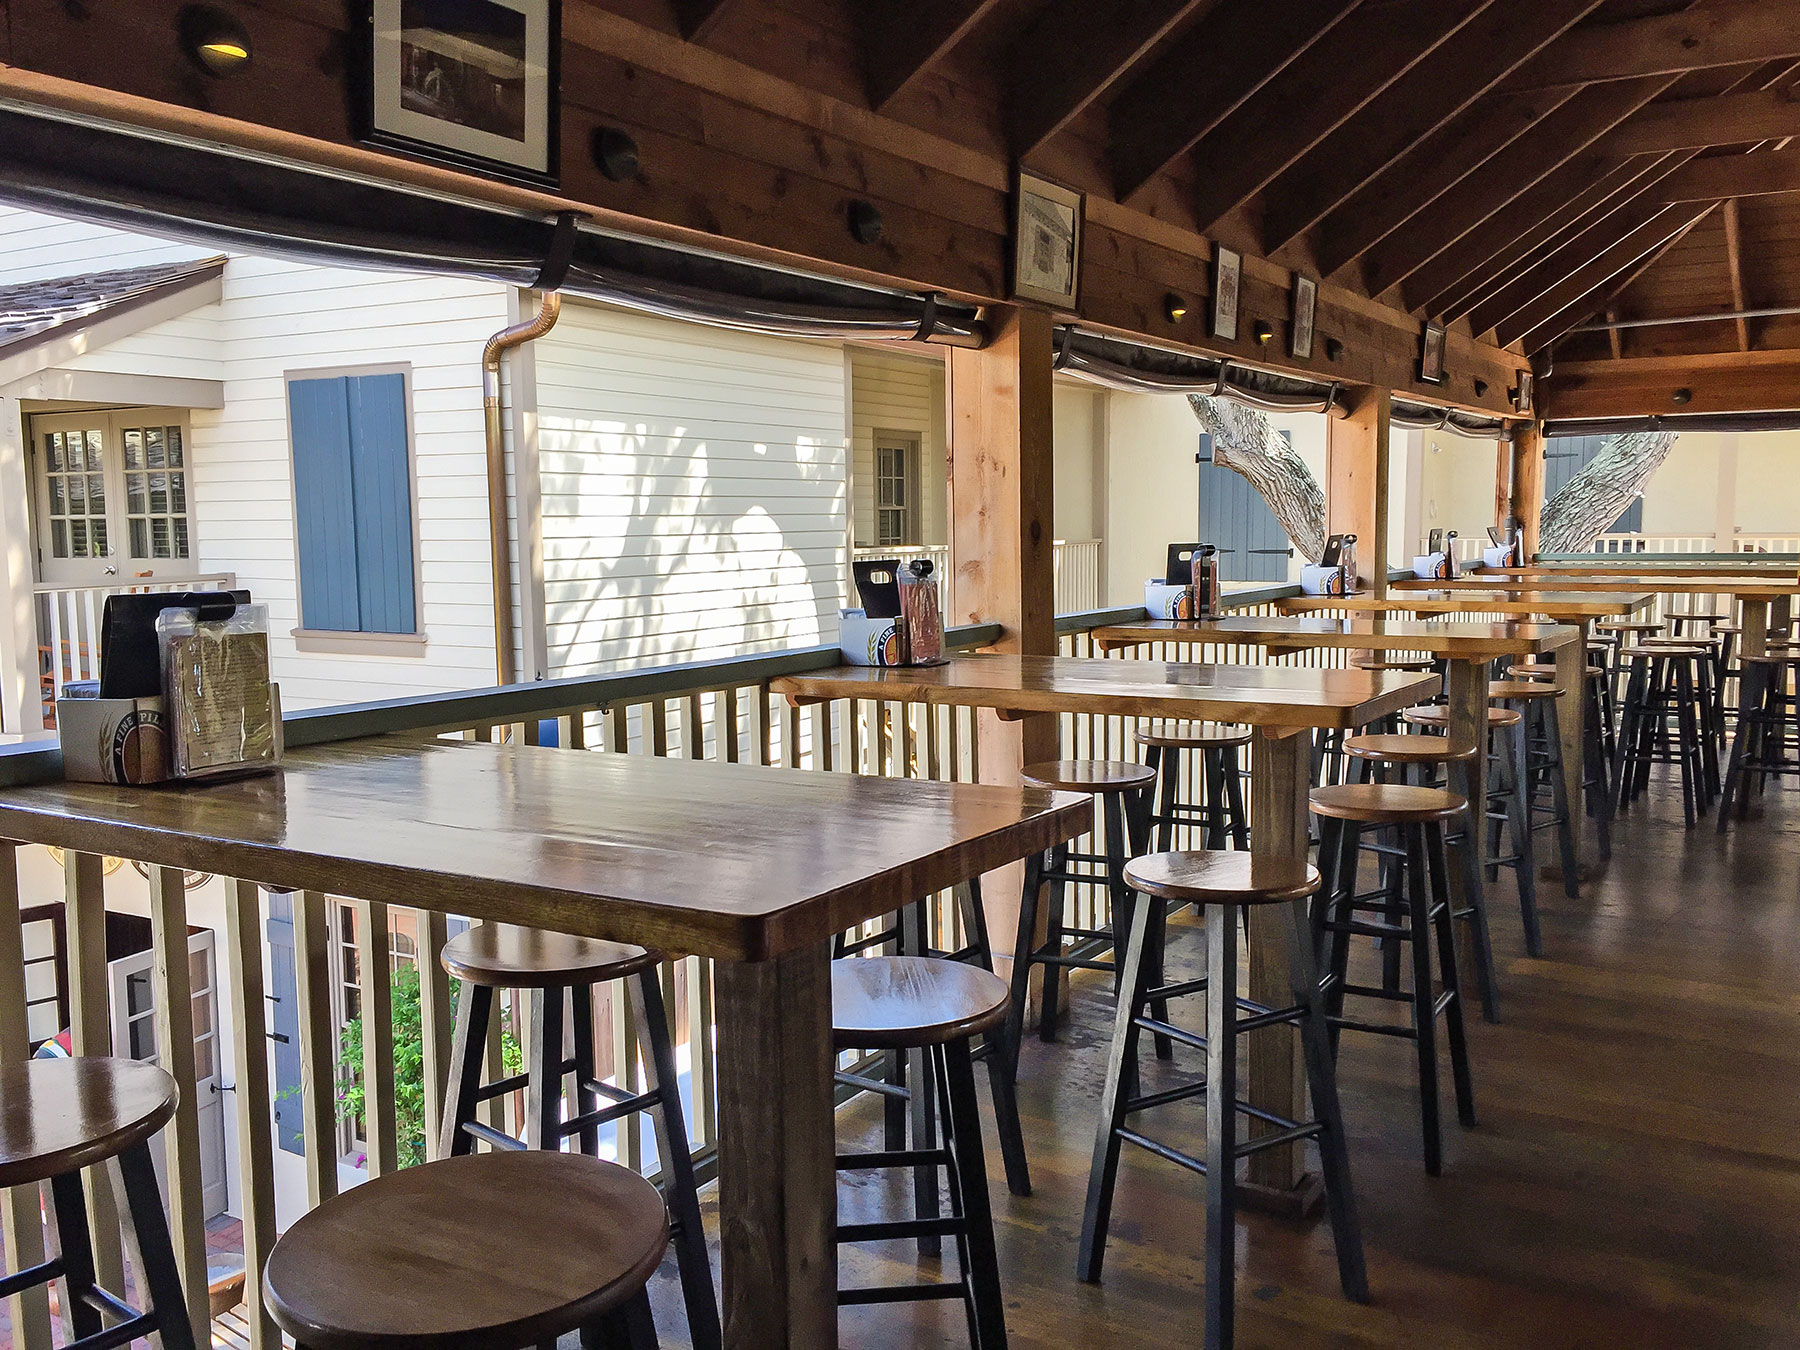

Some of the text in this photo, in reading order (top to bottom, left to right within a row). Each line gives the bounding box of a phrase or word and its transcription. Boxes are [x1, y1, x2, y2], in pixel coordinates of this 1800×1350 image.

[114, 712, 159, 756] A FINE PIL
